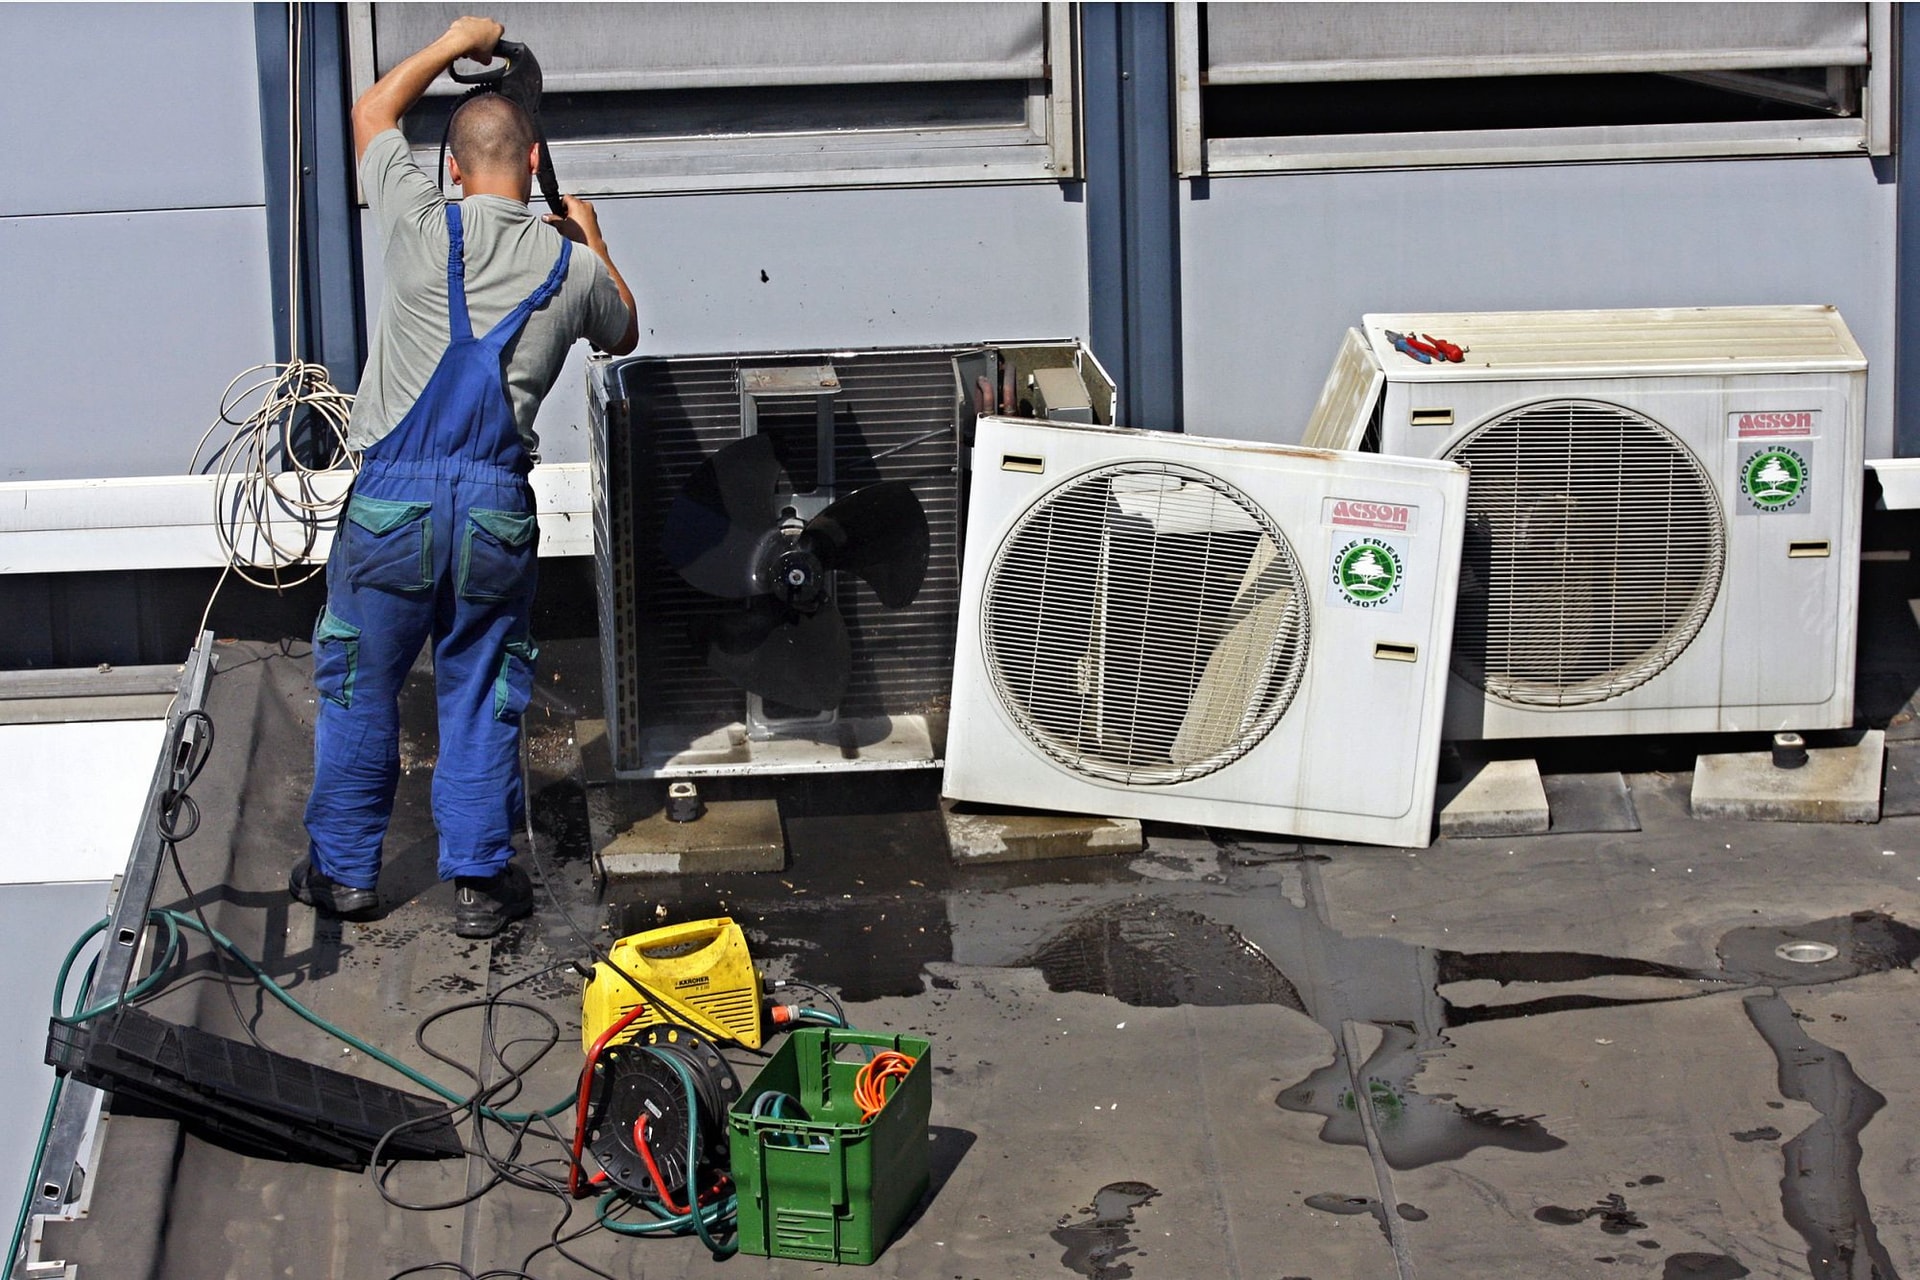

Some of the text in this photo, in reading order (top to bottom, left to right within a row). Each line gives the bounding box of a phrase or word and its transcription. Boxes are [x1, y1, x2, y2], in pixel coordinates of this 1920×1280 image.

[1740, 446, 1808, 494] OZONE FRIENDLY
[1753, 499, 1796, 512] R407C
[1332, 538, 1403, 593] OZONE FRIENDLY
[1343, 594, 1388, 608] R407C
